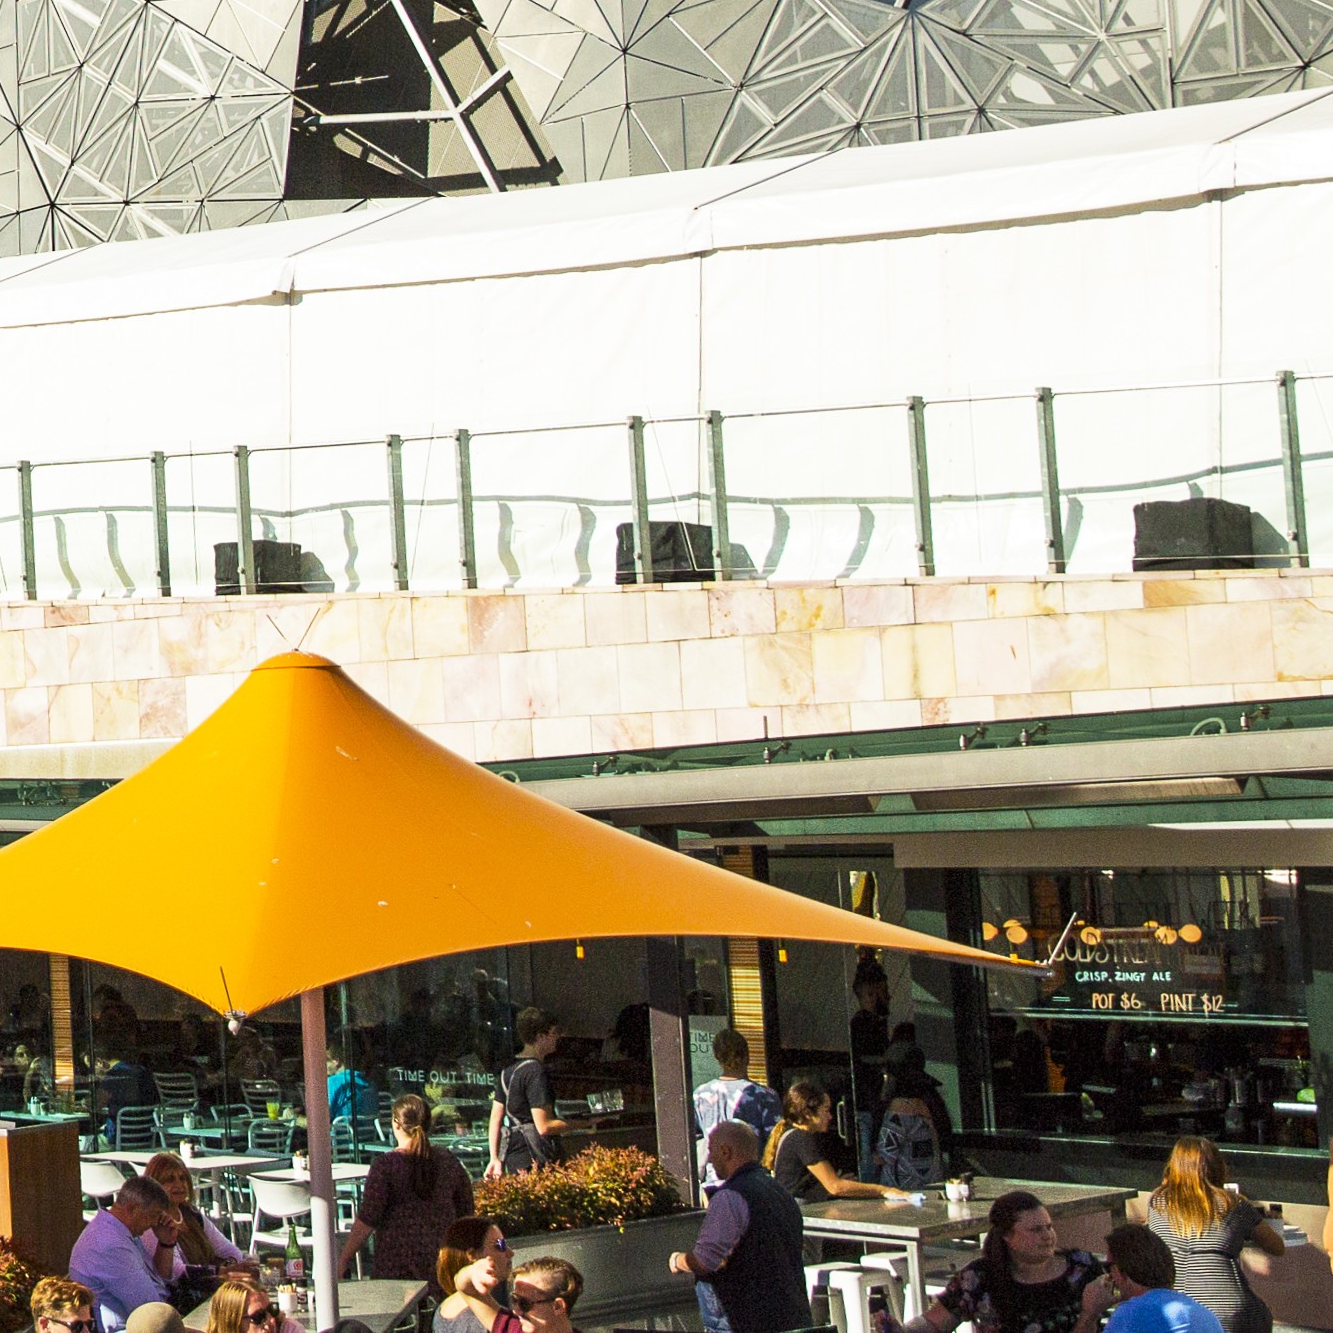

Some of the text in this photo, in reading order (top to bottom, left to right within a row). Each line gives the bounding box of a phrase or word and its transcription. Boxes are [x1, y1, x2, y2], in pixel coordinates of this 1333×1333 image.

[1114, 971, 1146, 982] ZINGY
[1152, 971, 1172, 982] ALE
[1092, 992, 1225, 1017] POT $6 PINT $12
[397, 1069, 495, 1085] TIME OUT TIME
